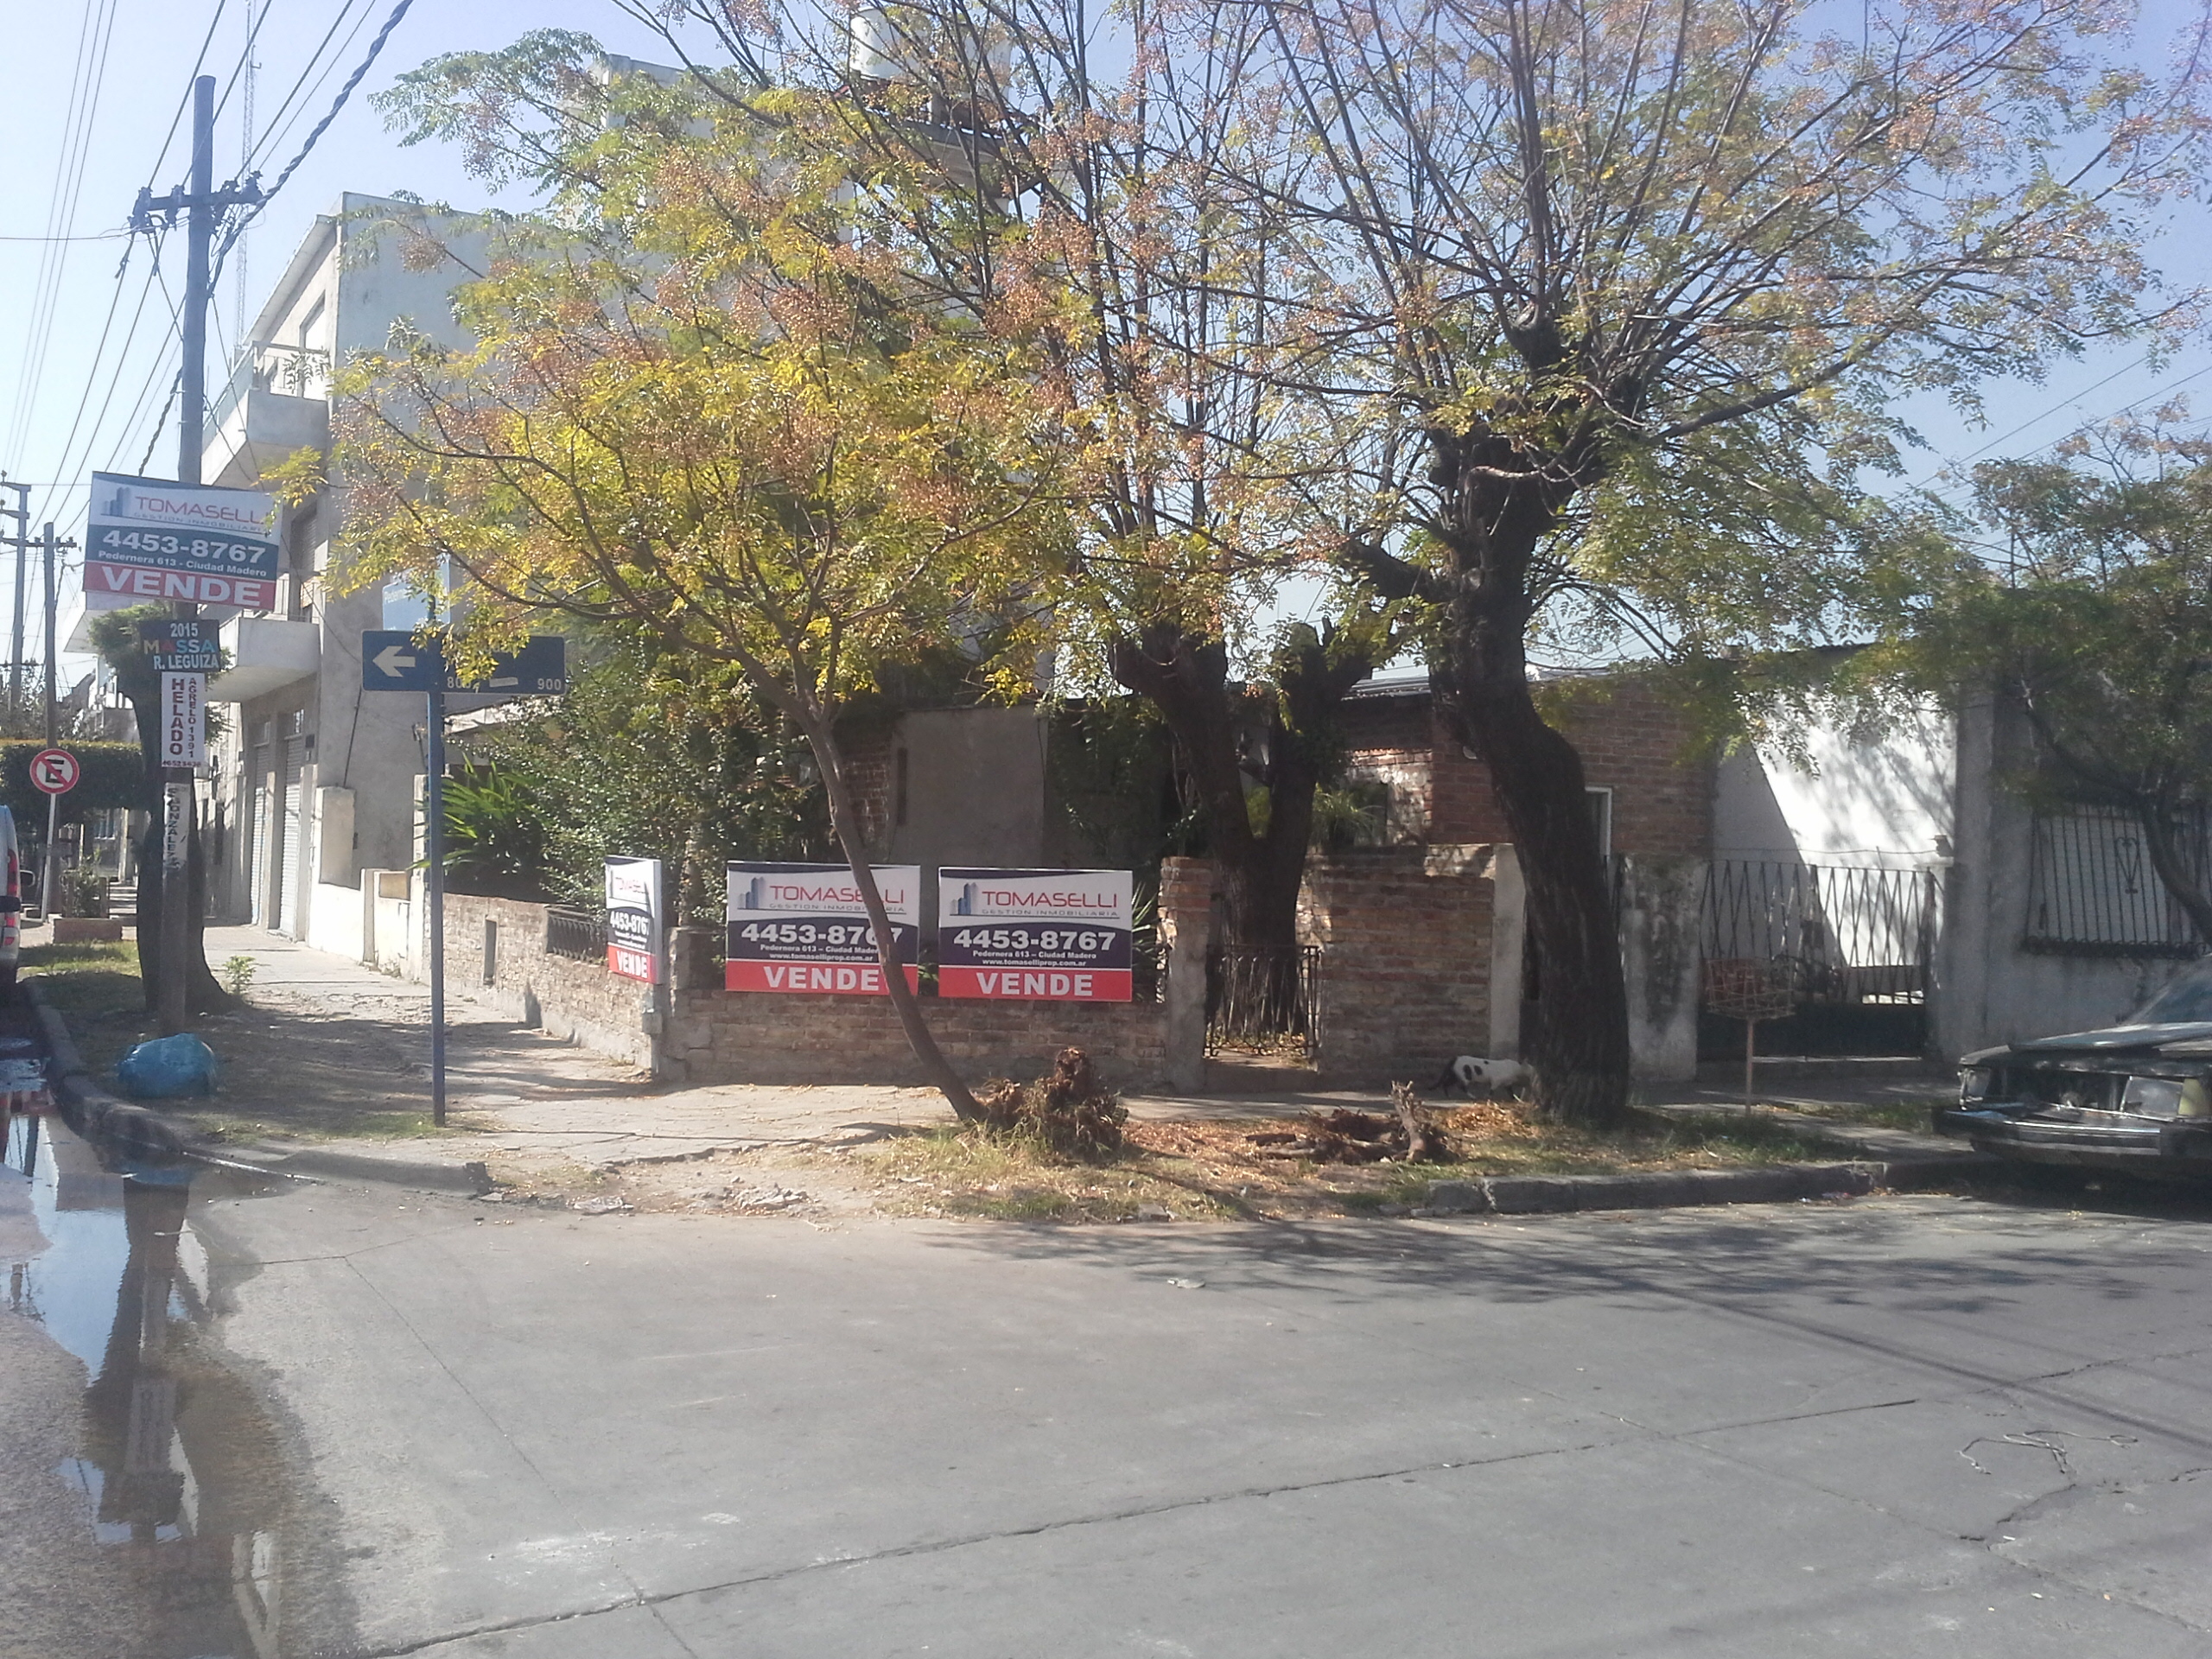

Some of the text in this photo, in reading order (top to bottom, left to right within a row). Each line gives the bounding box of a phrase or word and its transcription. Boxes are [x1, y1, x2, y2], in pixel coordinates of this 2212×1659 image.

[135, 495, 269, 525] TOMASELL
[102, 530, 266, 564] 4453-8767
[99, 550, 154, 565] Pedernera
[157, 557, 176, 568] 613
[187, 561, 224, 573] Ciudad
[226, 565, 267, 577] Madero
[101, 566, 262, 607] VENDE
[170, 622, 199, 638] 2015
[143, 639, 215, 655] MASSA
[154, 654, 219, 670] R. LEGUIZA
[537, 677, 562, 690] 900
[169, 677, 185, 755] HELADO
[770, 885, 904, 904] TOMASELI
[982, 891, 1117, 907] TOMASELLI
[609, 911, 651, 936] 4453-8767
[760, 944, 801, 952] Pedernera
[953, 929, 1116, 951] 4453-8767
[616, 950, 648, 979] VENDE
[769, 952, 874, 962] www.tomaselliprop.com.ar
[982, 958, 1087, 967] www.tomaselliprop.com.ar
[1038, 950, 1065, 959] Ciudad
[763, 966, 880, 991] VENDE
[976, 972, 1093, 997] VENDE
